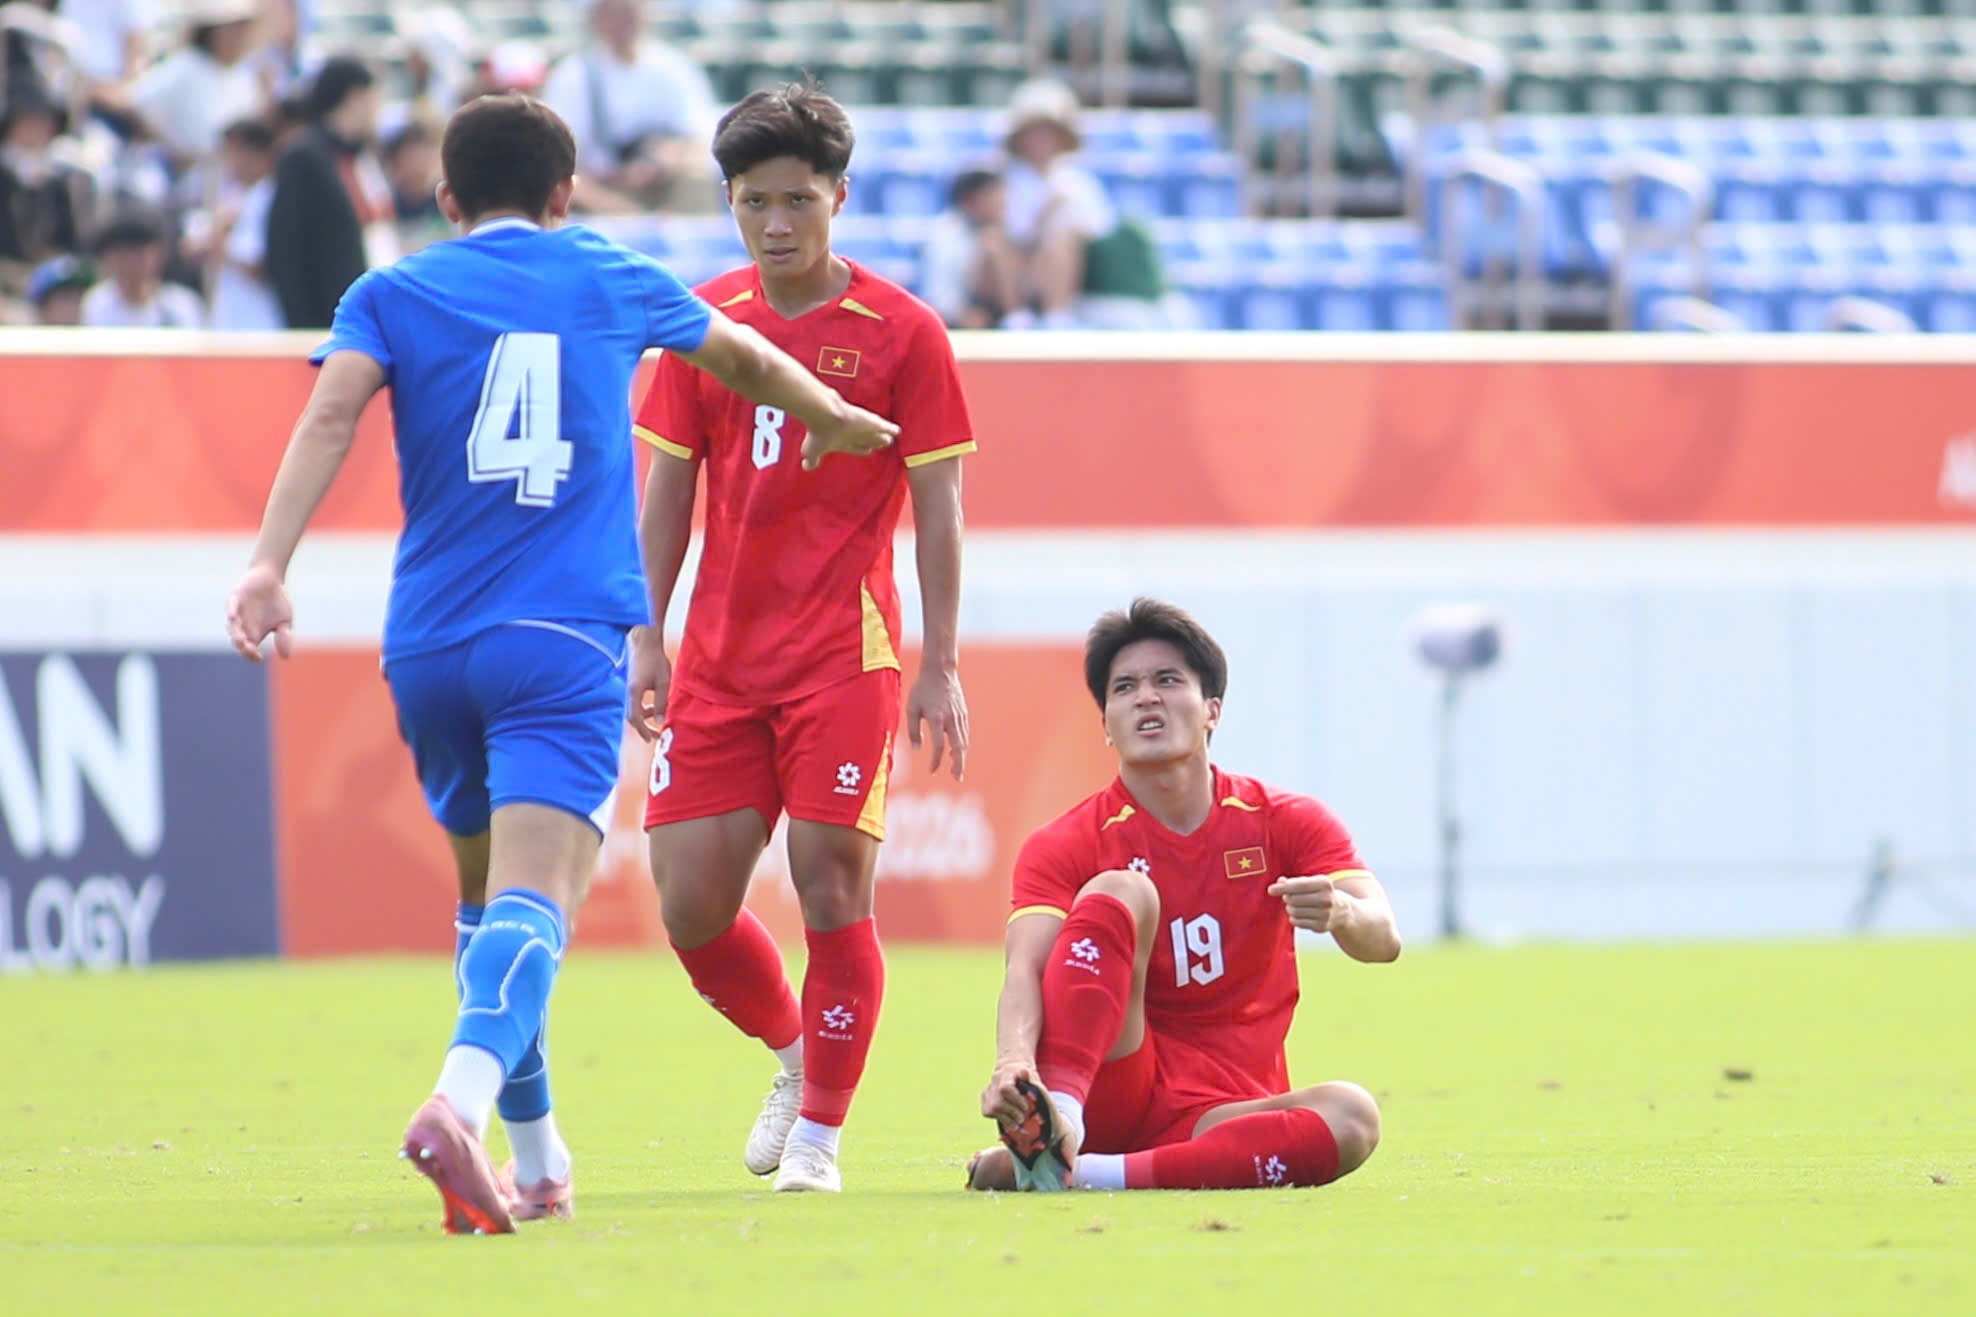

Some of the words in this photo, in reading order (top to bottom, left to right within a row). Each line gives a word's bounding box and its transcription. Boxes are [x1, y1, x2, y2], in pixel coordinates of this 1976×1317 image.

[466, 332, 573, 508] 4
[751, 404, 785, 470] 8
[649, 727, 674, 797] 8
[1170, 912, 1225, 988] 19
